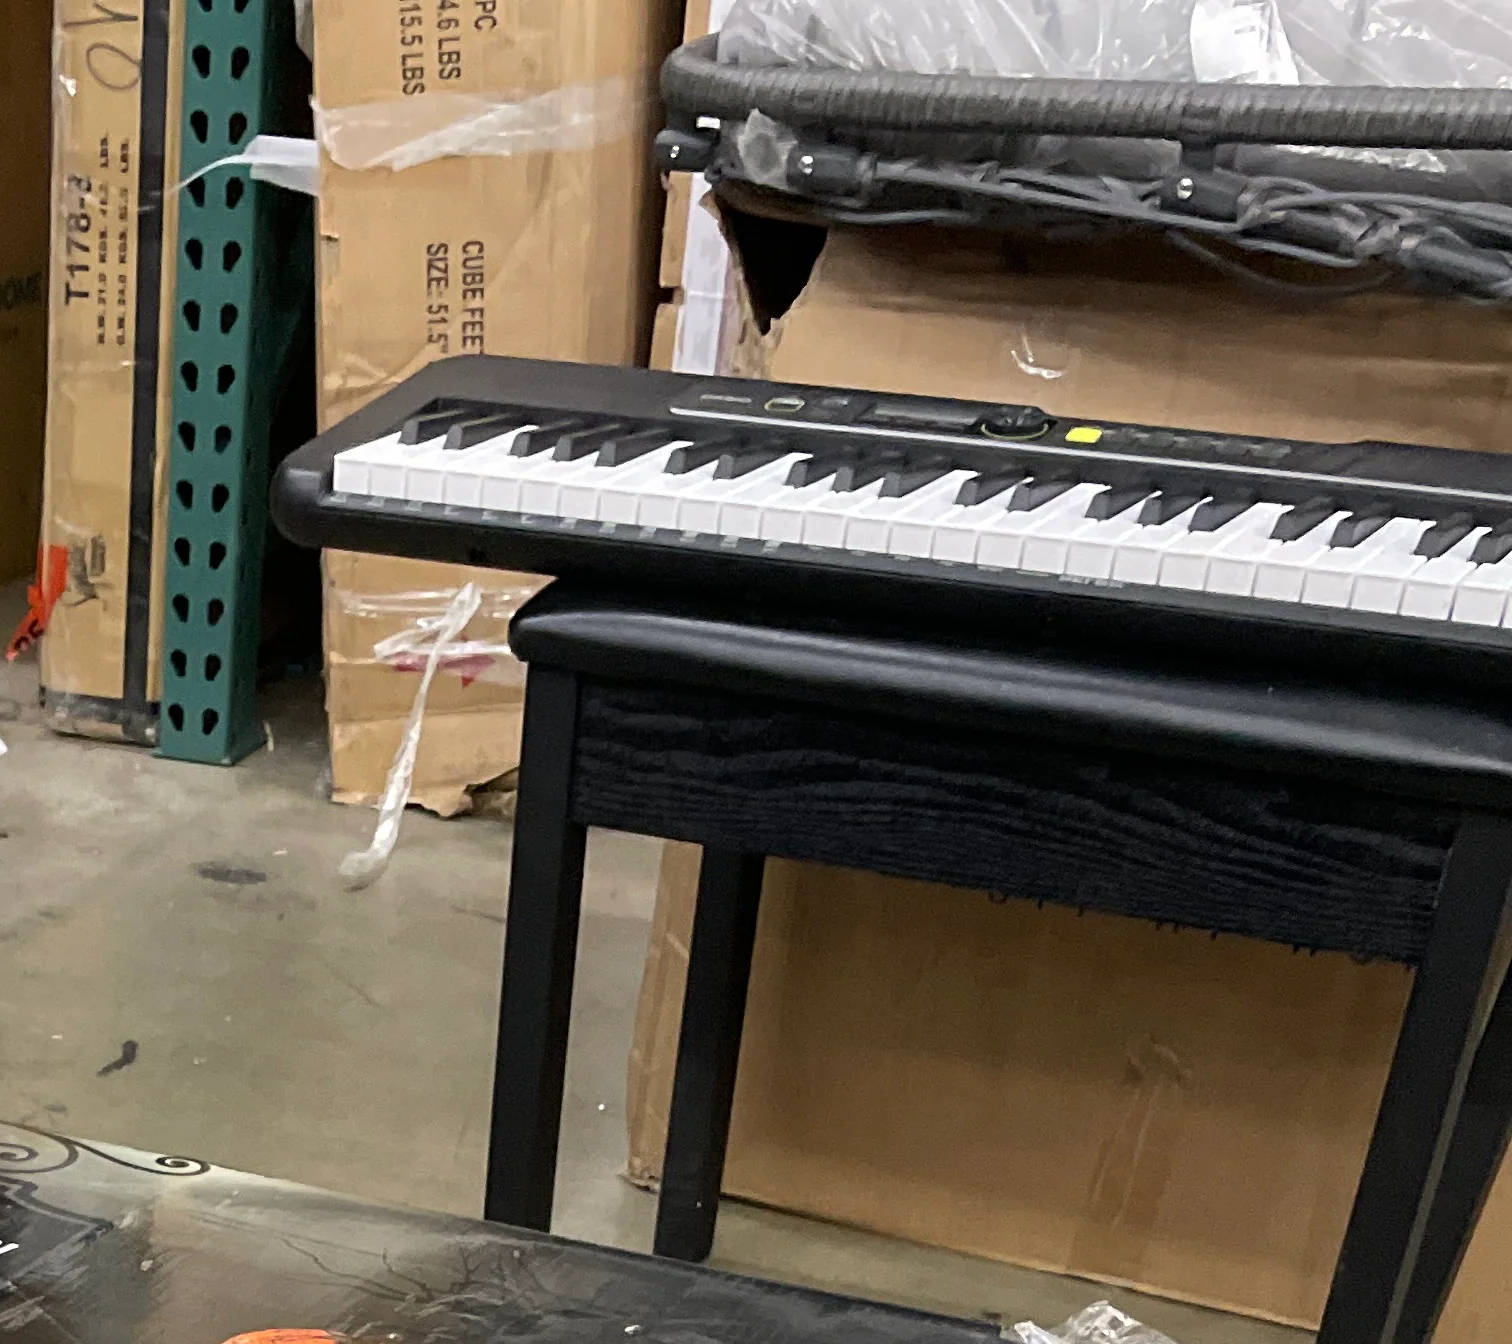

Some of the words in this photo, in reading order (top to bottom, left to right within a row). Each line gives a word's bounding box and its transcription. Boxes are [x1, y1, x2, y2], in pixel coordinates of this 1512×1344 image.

[401, 53, 425, 96] LBS
[437, 36, 461, 80] LBS
[427, 243, 448, 296] SIZE:
[462, 241, 484, 301] CUBE
[462, 307, 484, 355] FEE
